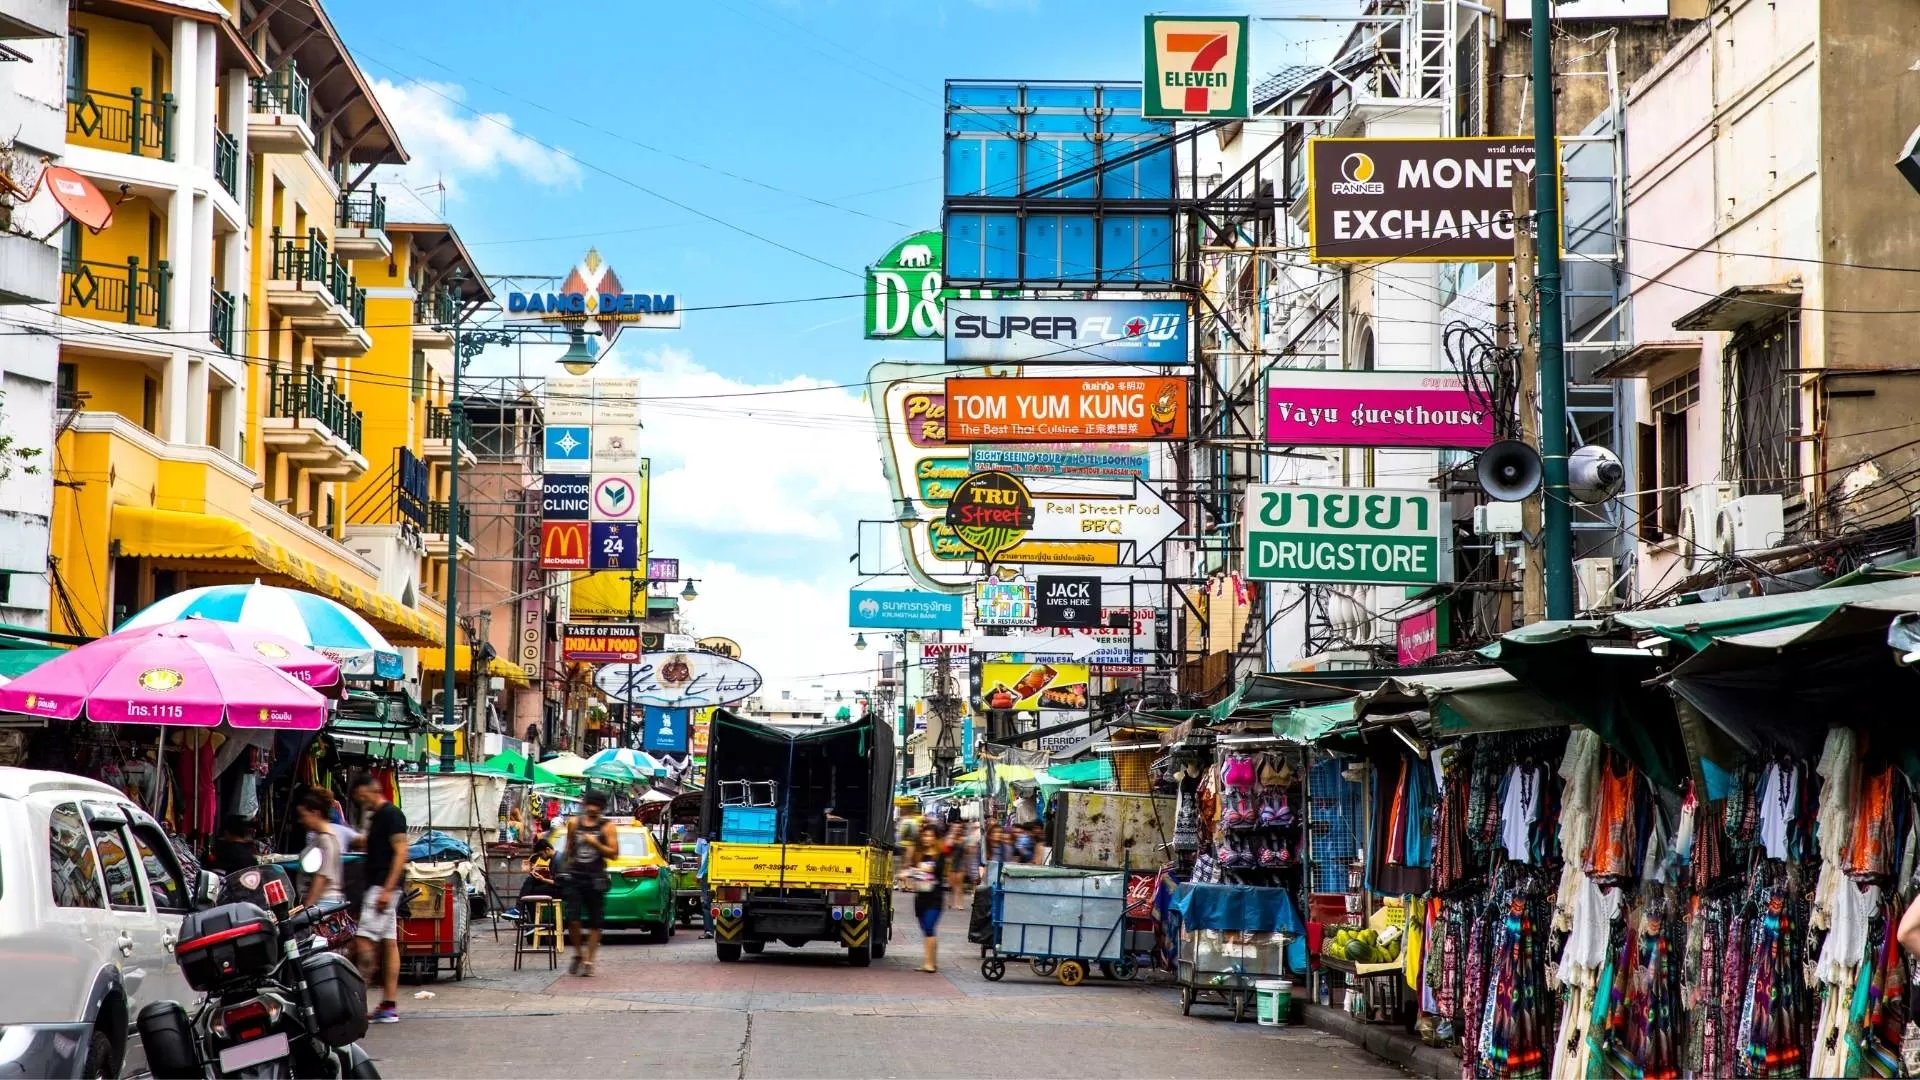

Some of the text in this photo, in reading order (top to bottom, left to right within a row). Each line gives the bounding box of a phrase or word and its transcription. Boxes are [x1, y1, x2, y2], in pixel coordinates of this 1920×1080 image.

[1332, 183, 1384, 194] PANNEE
[509, 292, 676, 315] DANG DERM
[870, 271, 945, 338] D&
[953, 394, 1145, 420] TOM YUM KUNG
[1277, 402, 1339, 427] Vayu
[959, 423, 976, 435] The
[983, 424, 1008, 434] Best
[1011, 423, 1035, 435] Thai
[1038, 423, 1080, 434] Cuisine
[975, 450, 1002, 461] SIGHT
[1003, 452, 1036, 462] SEEING
[1037, 453, 1062, 463] TOUR
[1072, 455, 1099, 465] HOTEL
[1102, 456, 1143, 466] BOOKING
[543, 484, 589, 494] DOCTOR
[970, 487, 1019, 506] TRU
[543, 499, 589, 511] CLINIC
[1046, 502, 1160, 515] Real Street Food
[1260, 491, 1429, 531] ขายยา
[960, 504, 1023, 528] Street
[1080, 519, 1123, 535] BBQ
[603, 538, 625, 553] 24
[1258, 540, 1428, 573] DRUGSTORE
[1046, 583, 1091, 598] JACK
[1046, 598, 1069, 606] LIVES
[997, 618, 1035, 626] RESTAURANT
[568, 627, 635, 636] TASTE OF INDIA
[523, 611, 539, 677] FOOD
[564, 637, 638, 653] INDIAN FOOD
[614, 664, 751, 696] The Club
[127, 699, 184, 718] โทร.1115
